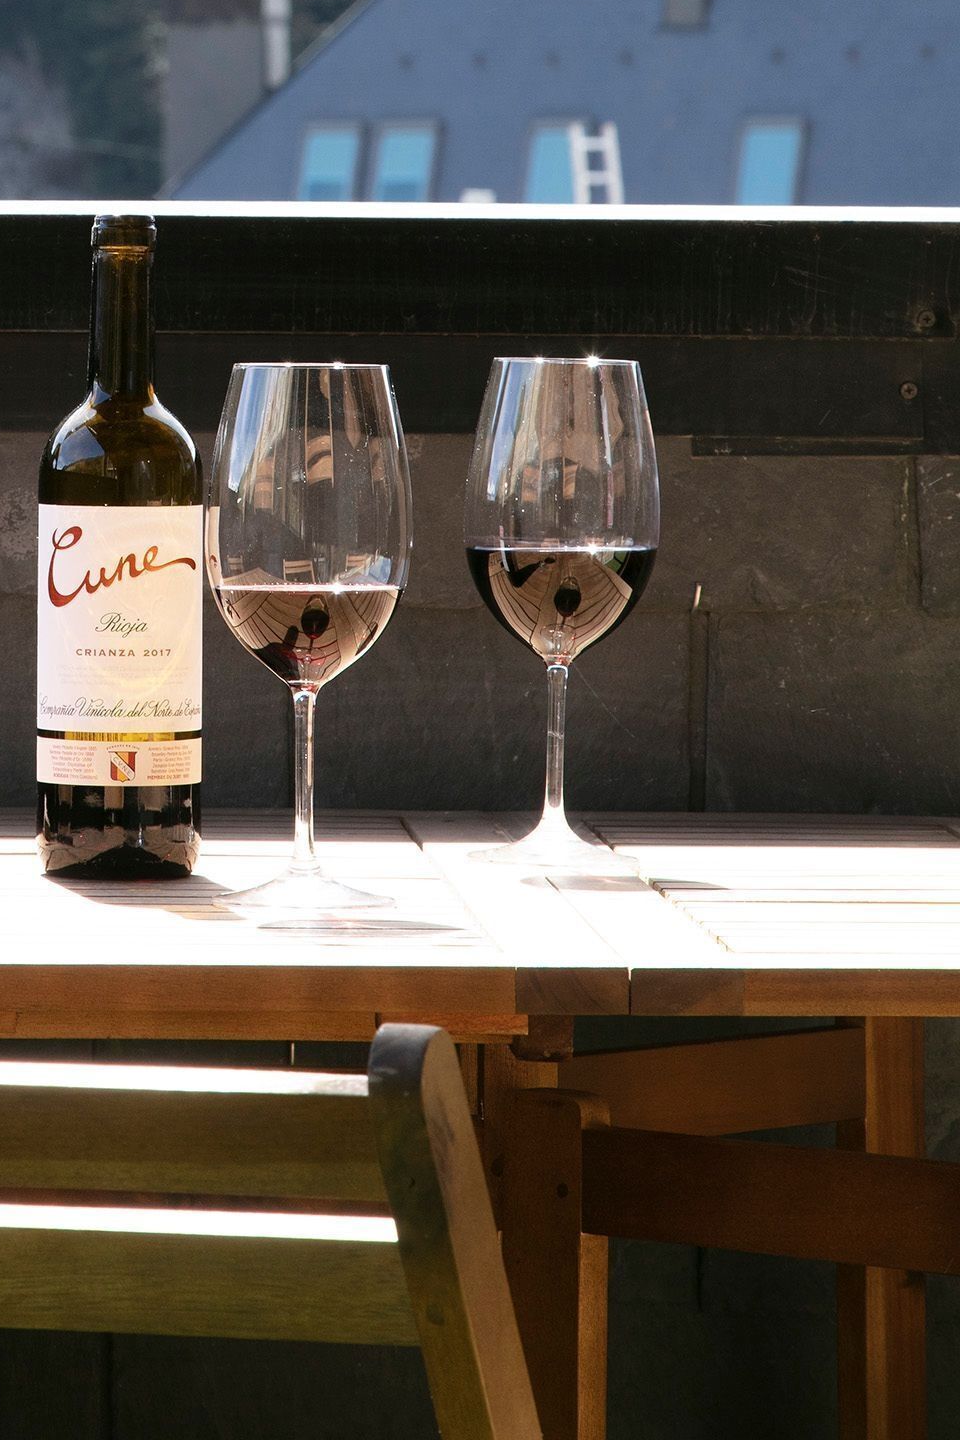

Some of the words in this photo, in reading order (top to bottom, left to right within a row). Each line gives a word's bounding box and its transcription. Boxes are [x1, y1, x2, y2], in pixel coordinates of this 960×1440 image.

[48, 526, 196, 607] Cune
[95, 612, 148, 638] Rioja
[76, 648, 136, 657] CRIANZA
[143, 648, 172, 657] 2017
[124, 701, 146, 717] del
[144, 699, 173, 717] Norte
[172, 702, 184, 716] de
